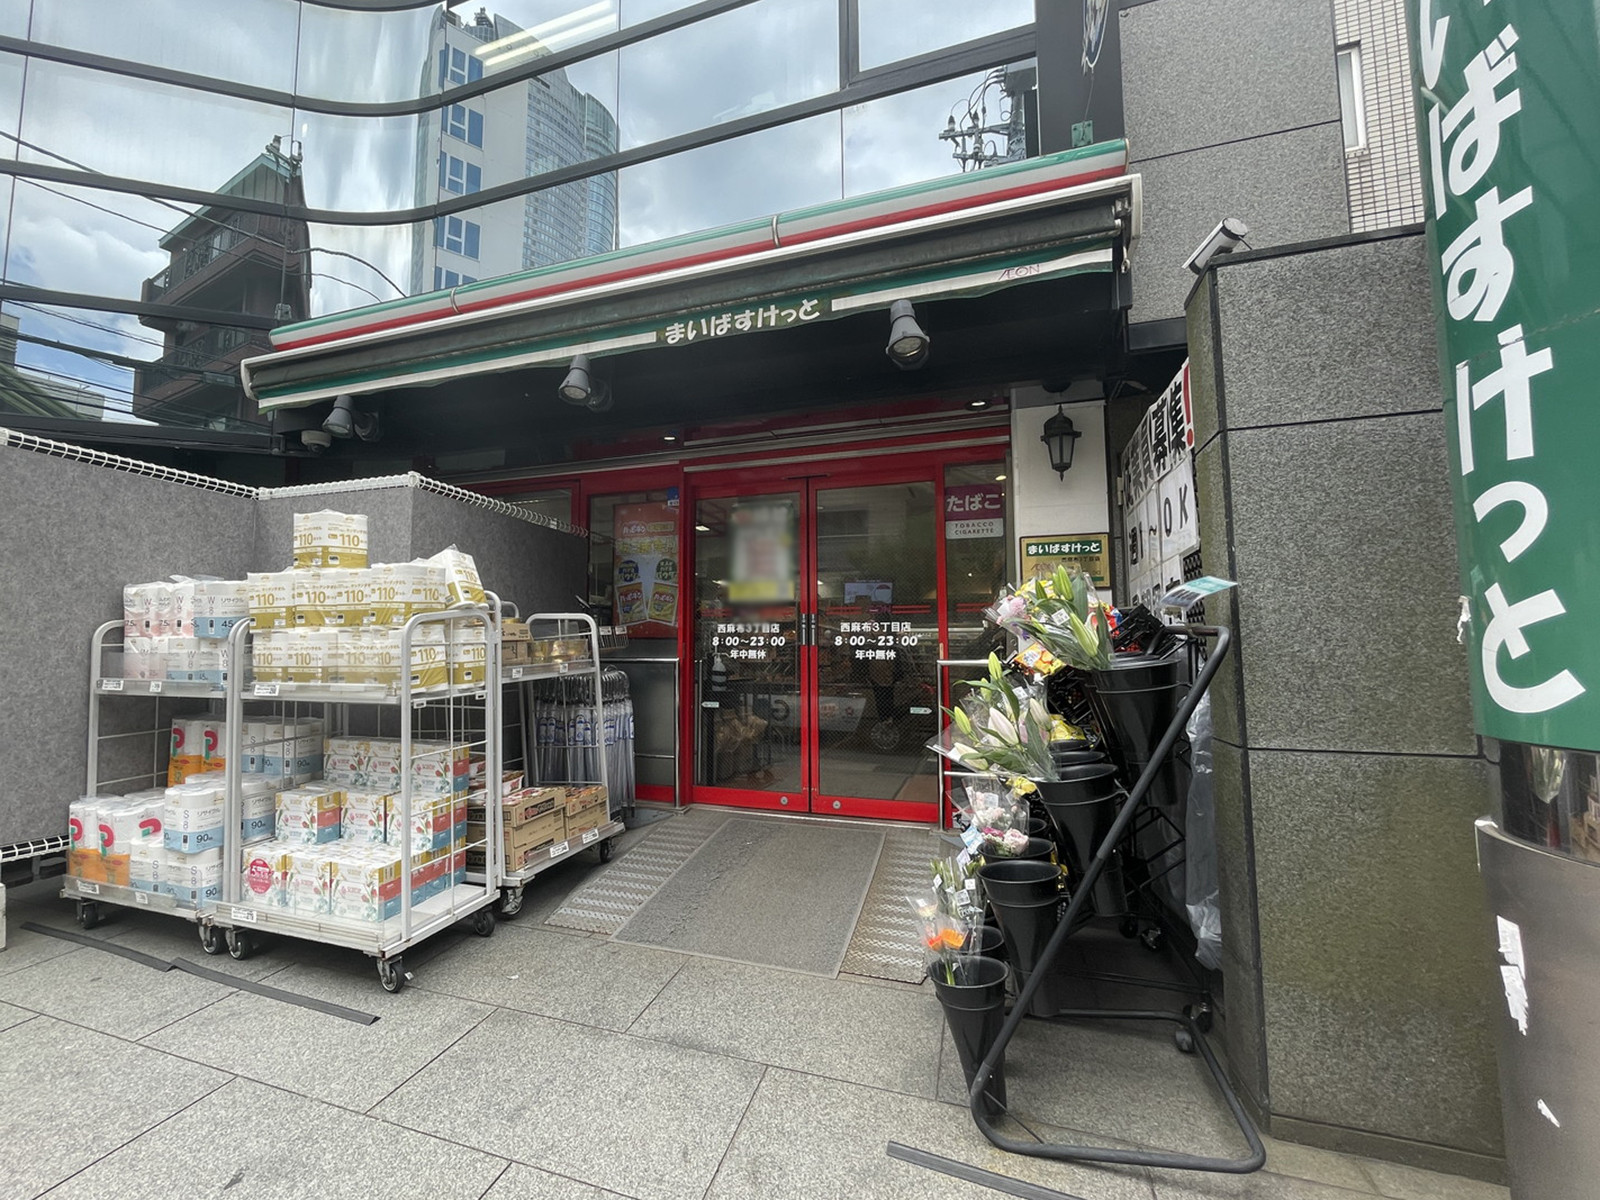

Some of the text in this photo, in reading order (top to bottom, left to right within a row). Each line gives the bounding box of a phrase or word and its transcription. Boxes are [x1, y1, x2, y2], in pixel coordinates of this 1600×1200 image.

[665, 299, 820, 344] まいばすけっと
[946, 492, 1001, 512] たばこ
[955, 521, 994, 529] TOBACCO
[299, 533, 313, 546] 110
[339, 534, 360, 547] 110
[1027, 542, 1100, 555] まいばすけっと
[255, 593, 275, 606] 110
[305, 591, 326, 604] 110
[344, 590, 365, 602] 110
[377, 587, 396, 601] 110
[717, 623, 780, 634] 西麻布3丁目店
[840, 621, 912, 633] 西麻布3丁目店
[257, 652, 273, 665] 110
[294, 652, 311, 665] 110
[418, 647, 438, 662] 110
[471, 648, 486, 660] 110
[730, 649, 767, 660] 年中無休
[855, 649, 897, 660] 年中無休
